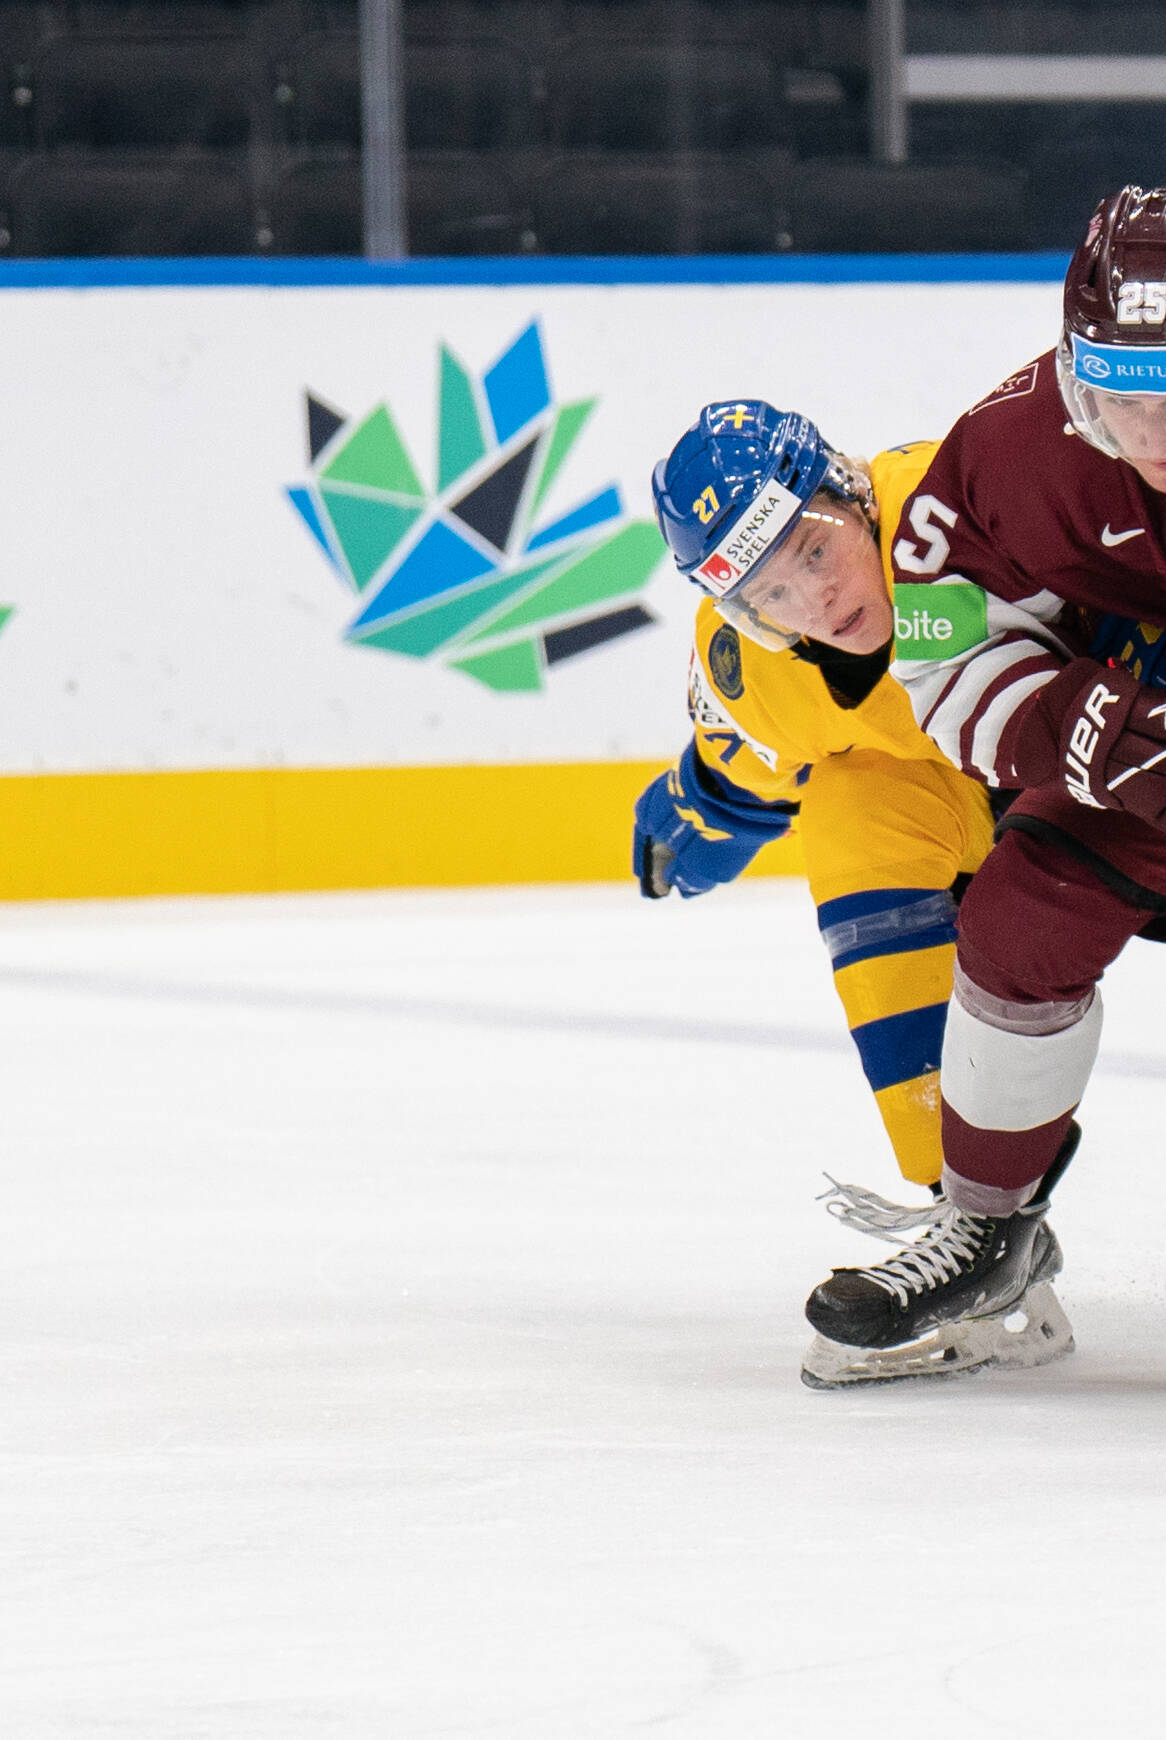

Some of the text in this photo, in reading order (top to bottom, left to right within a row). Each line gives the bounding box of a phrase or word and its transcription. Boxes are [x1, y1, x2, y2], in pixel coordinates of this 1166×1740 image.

[693, 485, 720, 524] 27
[727, 497, 780, 558] SVENSKA
[739, 536, 770, 567] SPEL
[894, 605, 953, 640] bite
